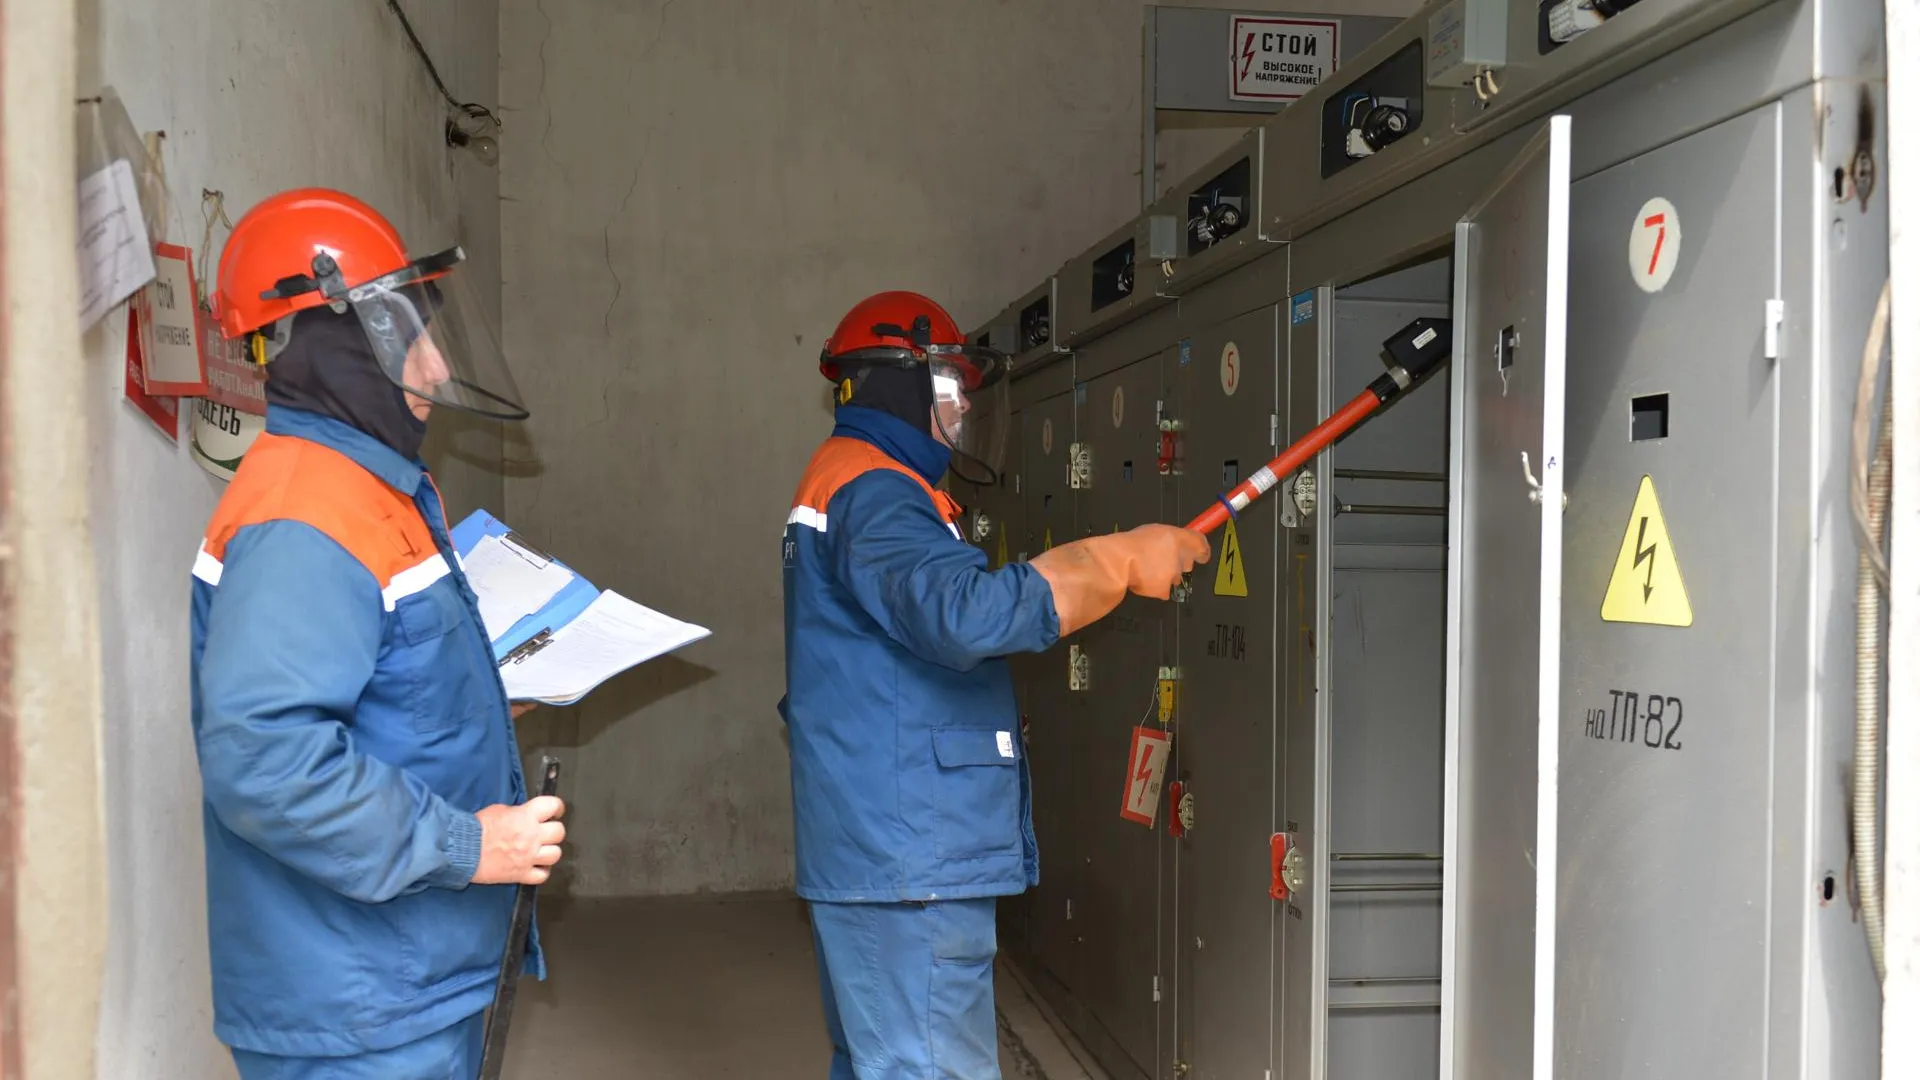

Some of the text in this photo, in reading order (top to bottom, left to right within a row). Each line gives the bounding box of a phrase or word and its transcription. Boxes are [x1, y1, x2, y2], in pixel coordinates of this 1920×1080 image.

[1262, 33, 1317, 57] СТОЙ
[1263, 61, 1315, 75] ВЫСОКОЕ
[1644, 212, 1665, 276] 7
[1227, 351, 1235, 388] 5
[1609, 689, 1682, 750] ТП-82
